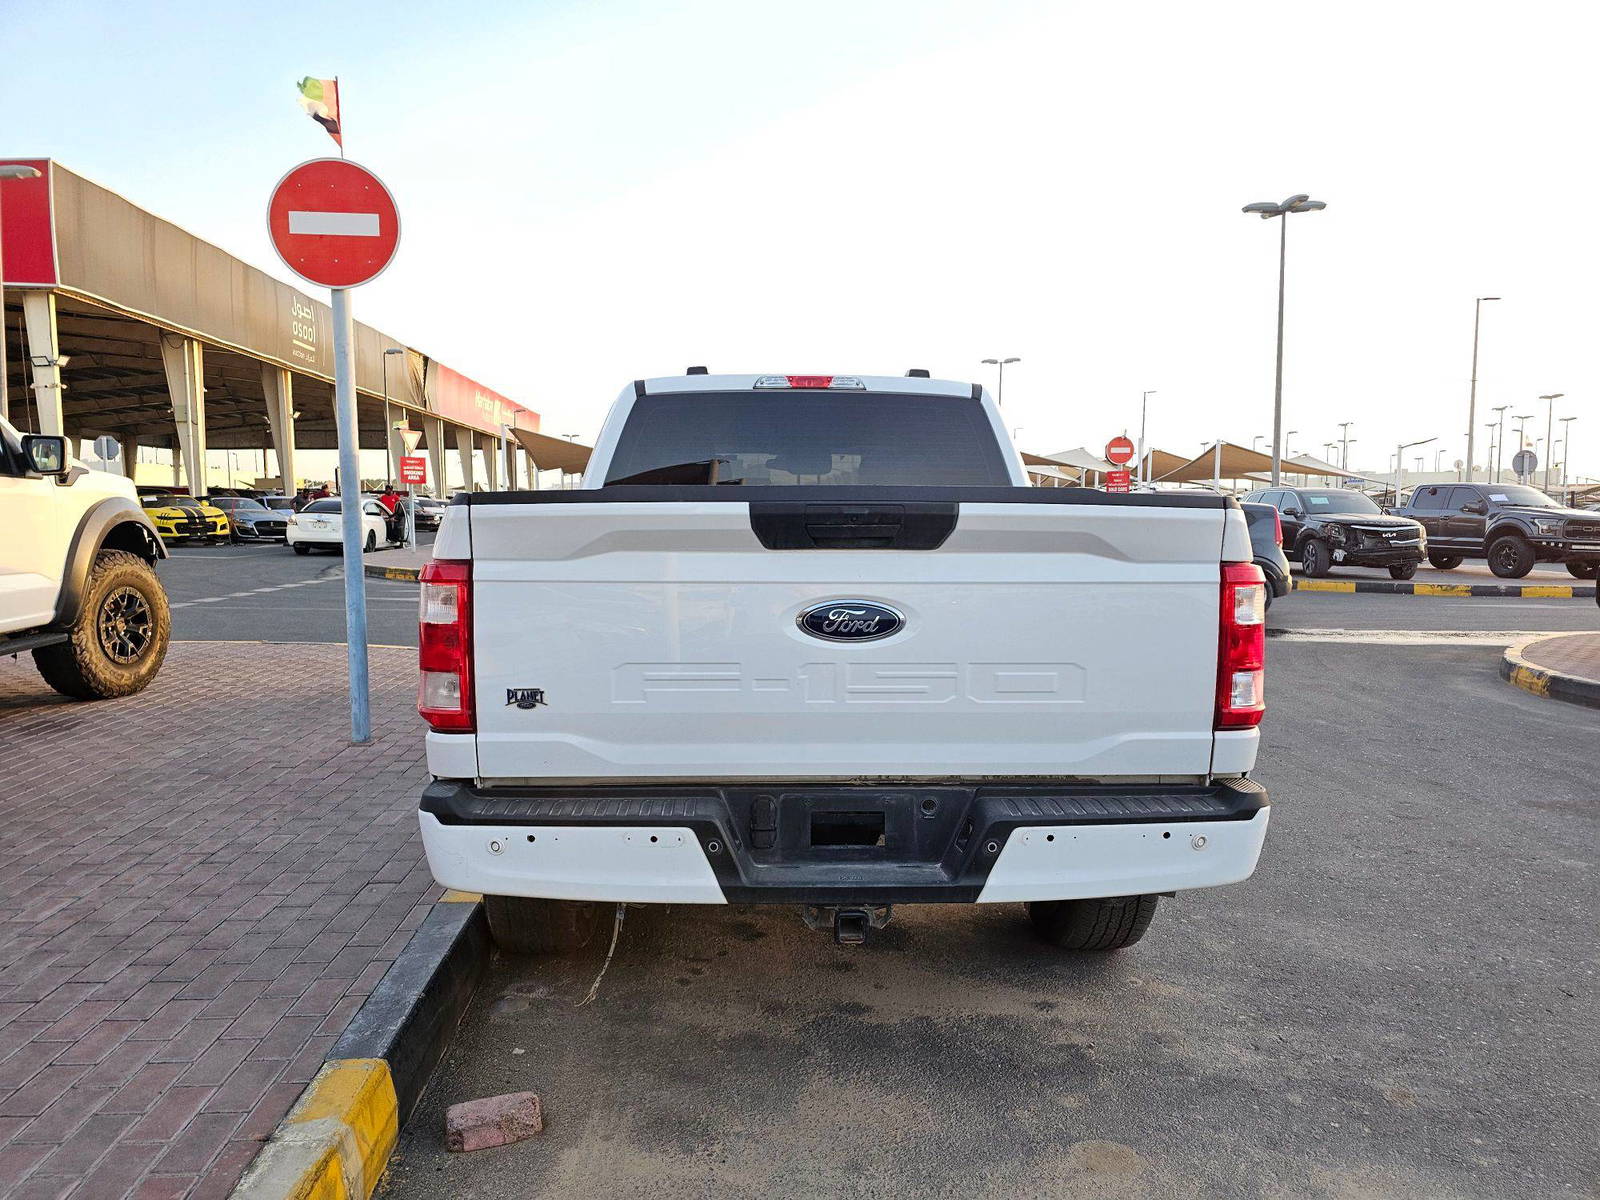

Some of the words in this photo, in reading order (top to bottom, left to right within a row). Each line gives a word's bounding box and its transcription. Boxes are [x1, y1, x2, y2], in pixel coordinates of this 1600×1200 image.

[822, 608, 880, 633] Ford
[611, 662, 1087, 704] F-150
[506, 688, 545, 705] PLANET
